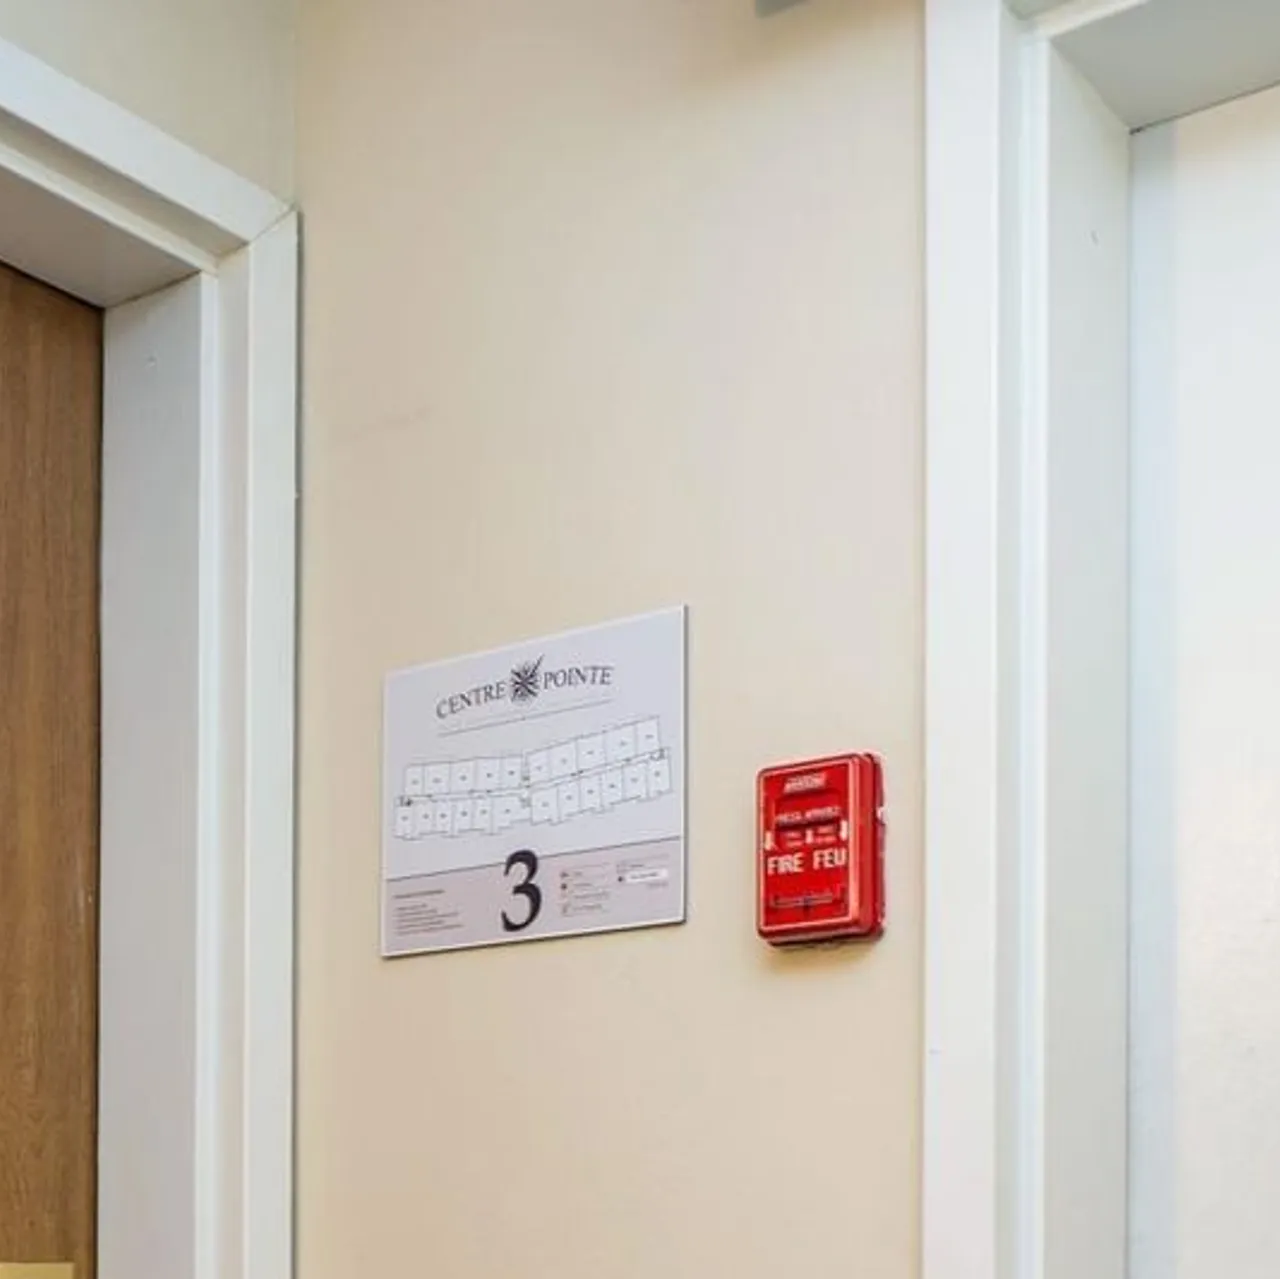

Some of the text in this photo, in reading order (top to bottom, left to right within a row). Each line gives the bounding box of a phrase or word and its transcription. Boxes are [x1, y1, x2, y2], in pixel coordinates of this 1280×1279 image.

[435, 665, 615, 719] CENTRE POINTE
[766, 847, 848, 876] FIRE FEU
[500, 848, 543, 933] 3
